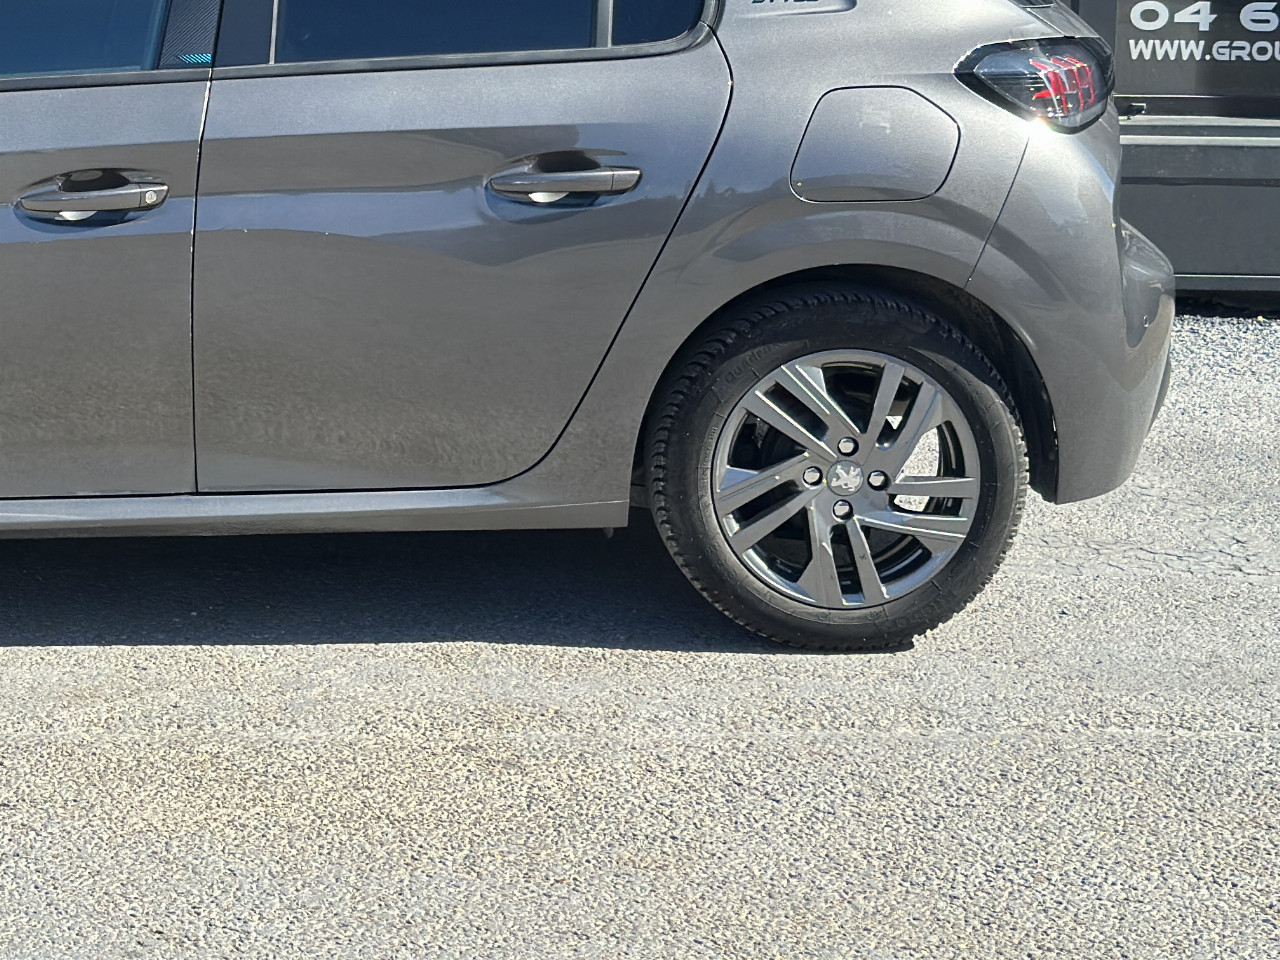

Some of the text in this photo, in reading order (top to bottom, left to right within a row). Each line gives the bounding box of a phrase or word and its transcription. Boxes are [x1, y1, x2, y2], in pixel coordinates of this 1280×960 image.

[1130, 1, 1279, 31] 04 6
[1129, 39, 1280, 60] WWW.GRO
